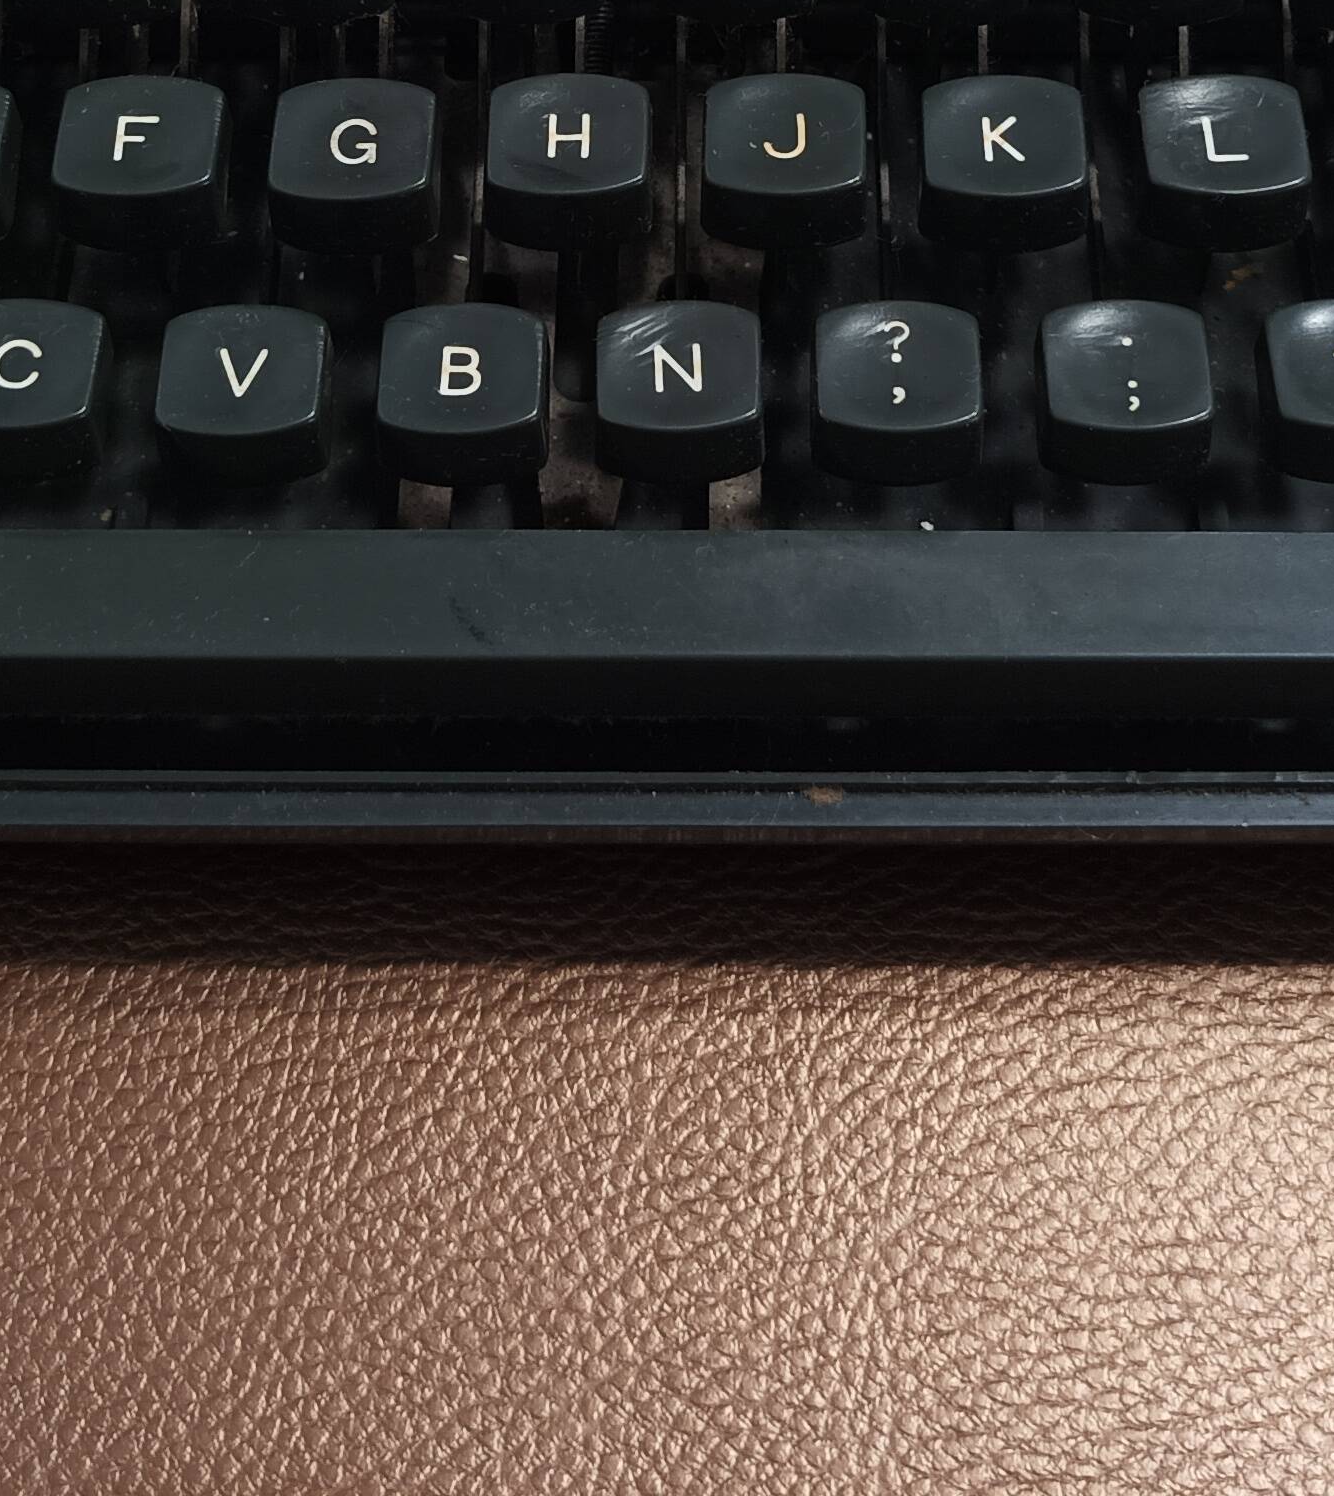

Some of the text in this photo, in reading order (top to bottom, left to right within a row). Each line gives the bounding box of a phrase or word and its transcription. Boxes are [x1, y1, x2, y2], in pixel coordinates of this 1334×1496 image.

[112, 114, 161, 163] F
[329, 117, 379, 166] G
[546, 112, 592, 160] H
[762, 112, 807, 160] J
[980, 115, 1025, 163] K
[1199, 115, 1250, 162] L
[883, 320, 912, 364] ?
[218, 347, 270, 399] V
[436, 344, 483, 397] B
[651, 340, 705, 394] N
[1126, 379, 1141, 413] ;
